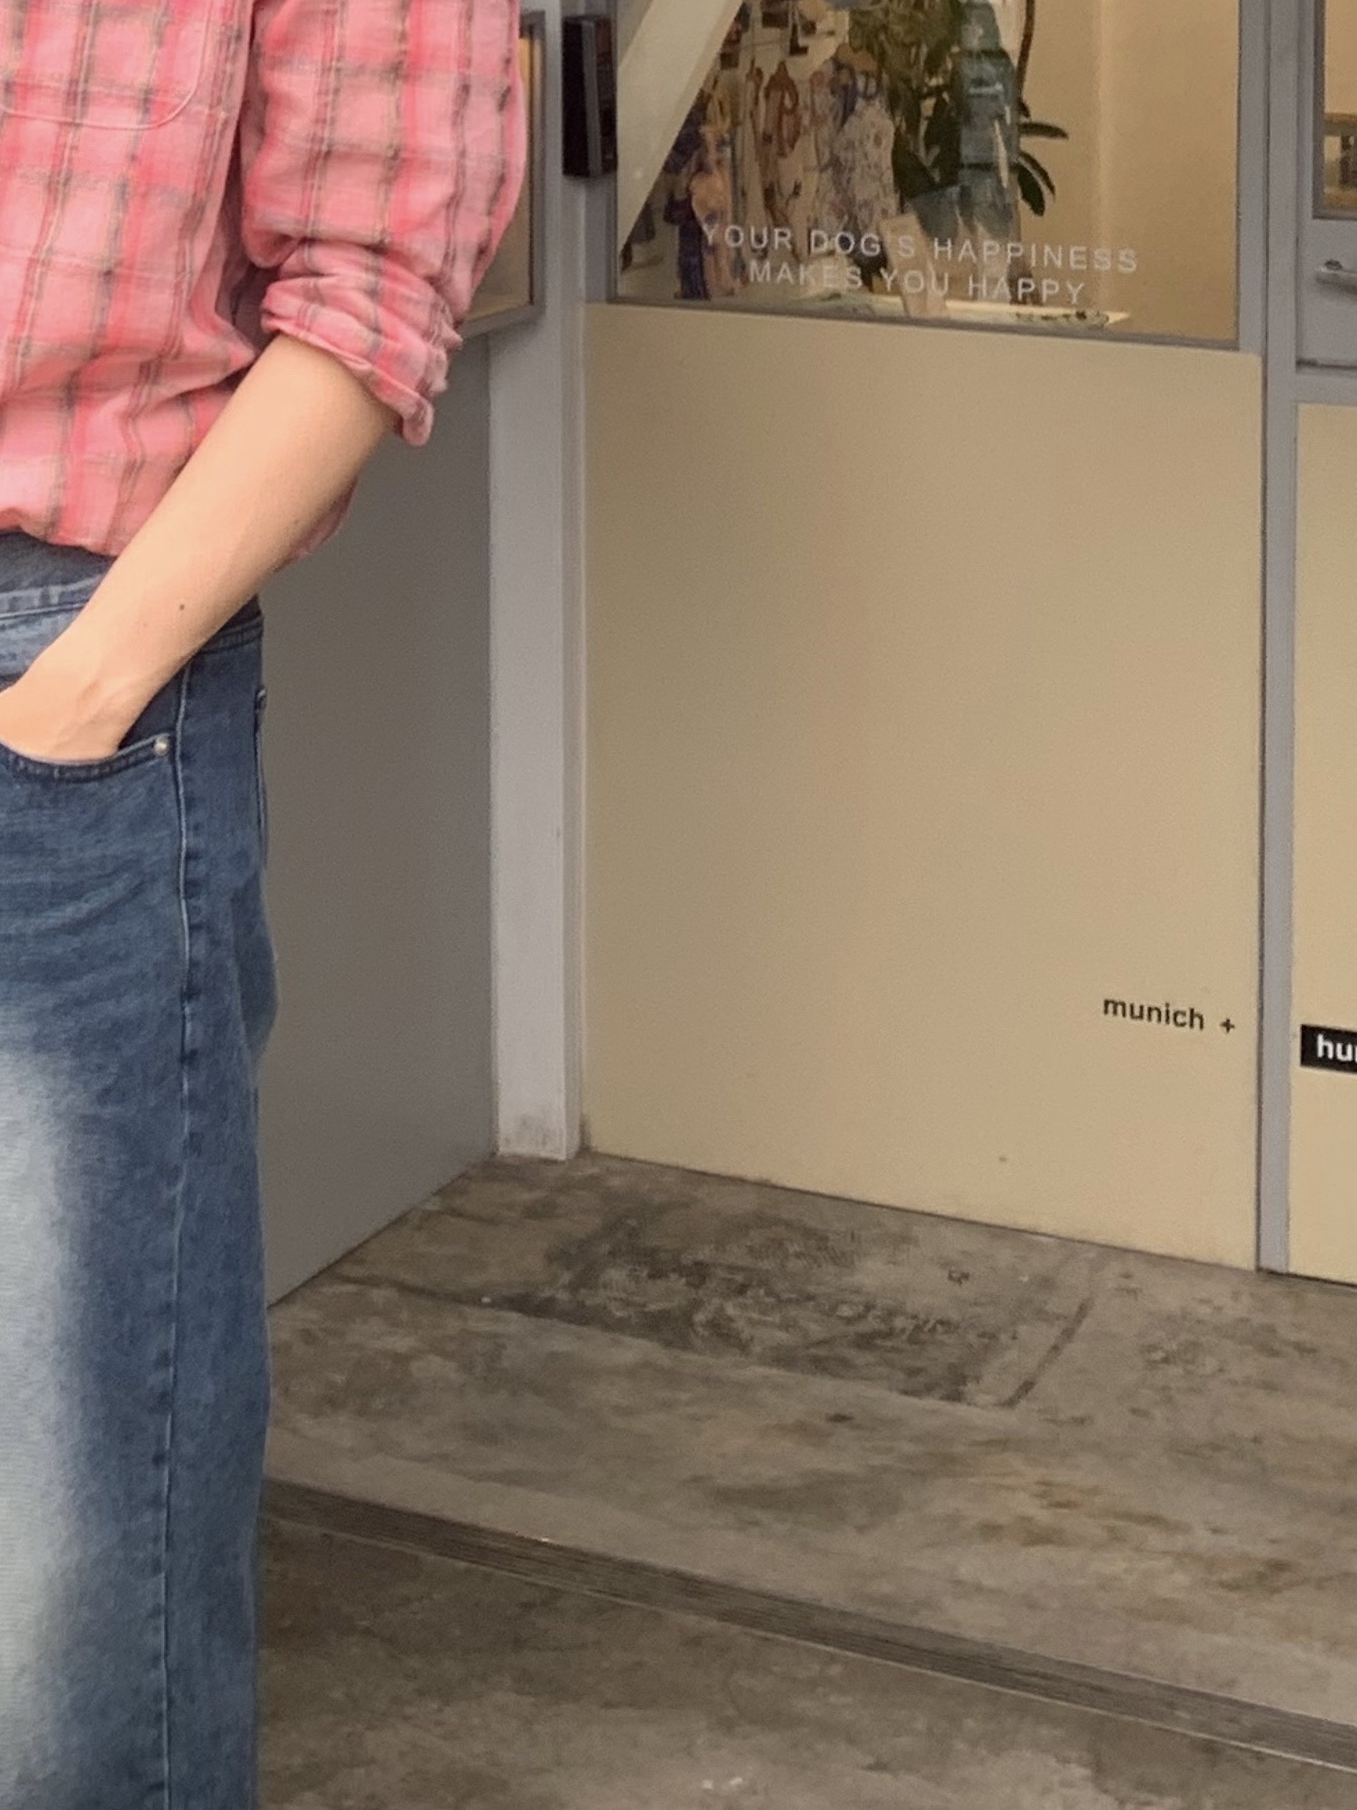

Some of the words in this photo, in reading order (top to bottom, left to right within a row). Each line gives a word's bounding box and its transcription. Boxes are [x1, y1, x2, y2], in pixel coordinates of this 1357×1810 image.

[702, 223, 792, 250] YOUR
[810, 229, 915, 257] DOGS
[933, 237, 1137, 273] HAPPINESS
[749, 261, 863, 290] MAKES
[880, 267, 949, 297] YOU
[968, 274, 1085, 305] HAPPY
[1103, 999, 1205, 1030] munich
[1317, 1033, 1357, 1064] hu
